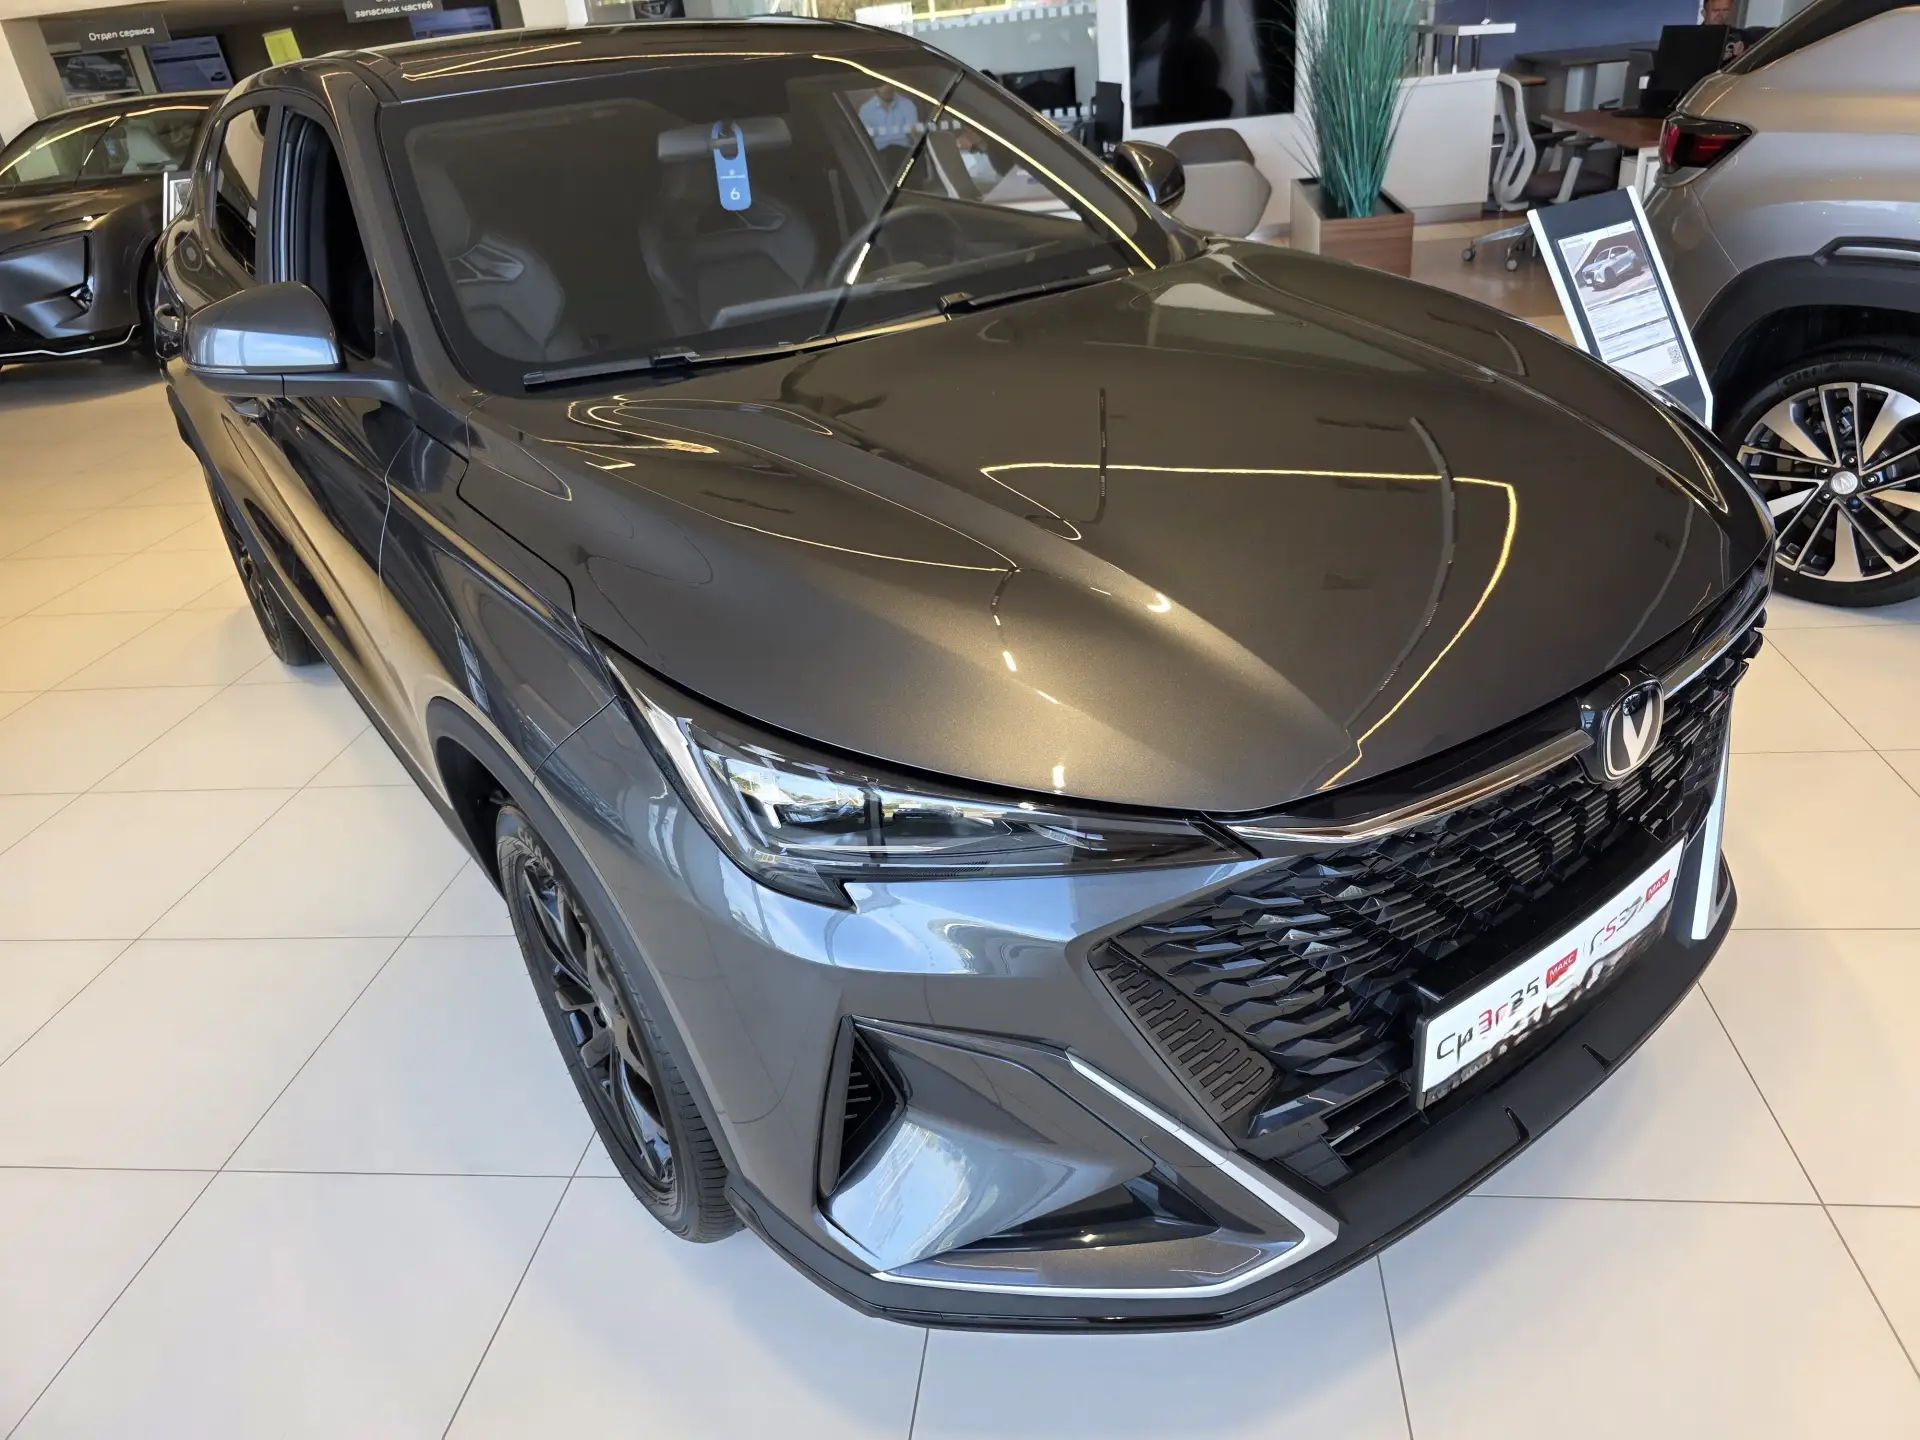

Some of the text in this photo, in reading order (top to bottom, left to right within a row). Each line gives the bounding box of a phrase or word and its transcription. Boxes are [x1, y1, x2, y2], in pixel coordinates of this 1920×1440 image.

[355, 0, 434, 18] запасных частей
[88, 26, 155, 42] Отдел сервиса
[730, 187, 740, 200] 6
